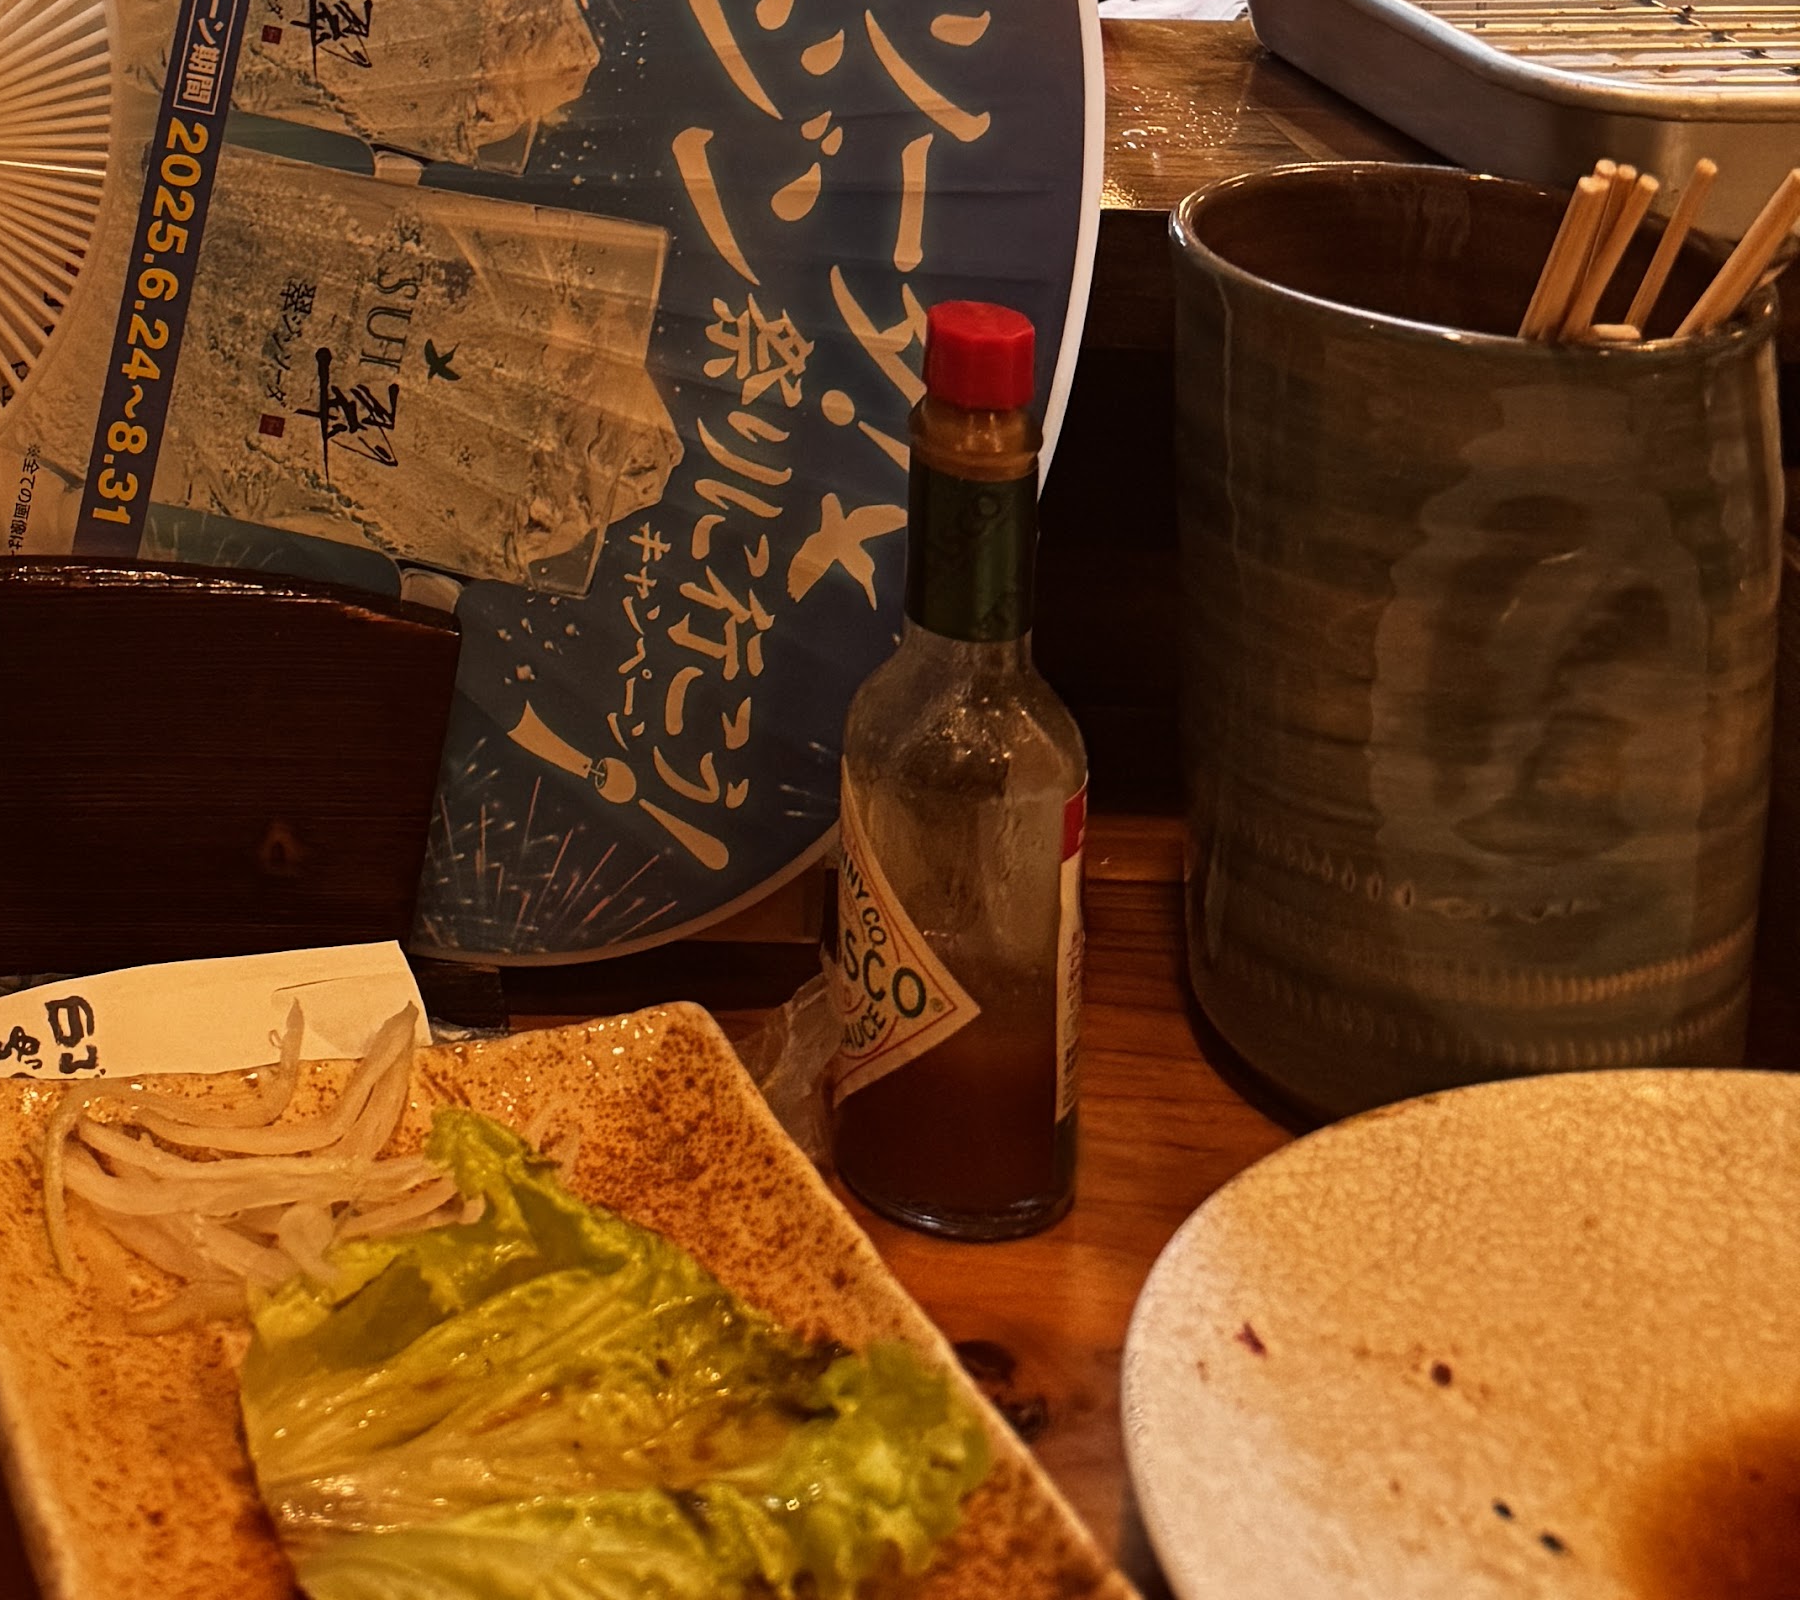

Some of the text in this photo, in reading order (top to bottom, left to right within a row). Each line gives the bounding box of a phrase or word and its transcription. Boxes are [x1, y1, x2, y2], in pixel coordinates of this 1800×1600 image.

[266, 281, 317, 409] 翠ジンソーダ
[8, 442, 41, 557] ※全ての画像は
[606, 520, 672, 751] キャンペーン
